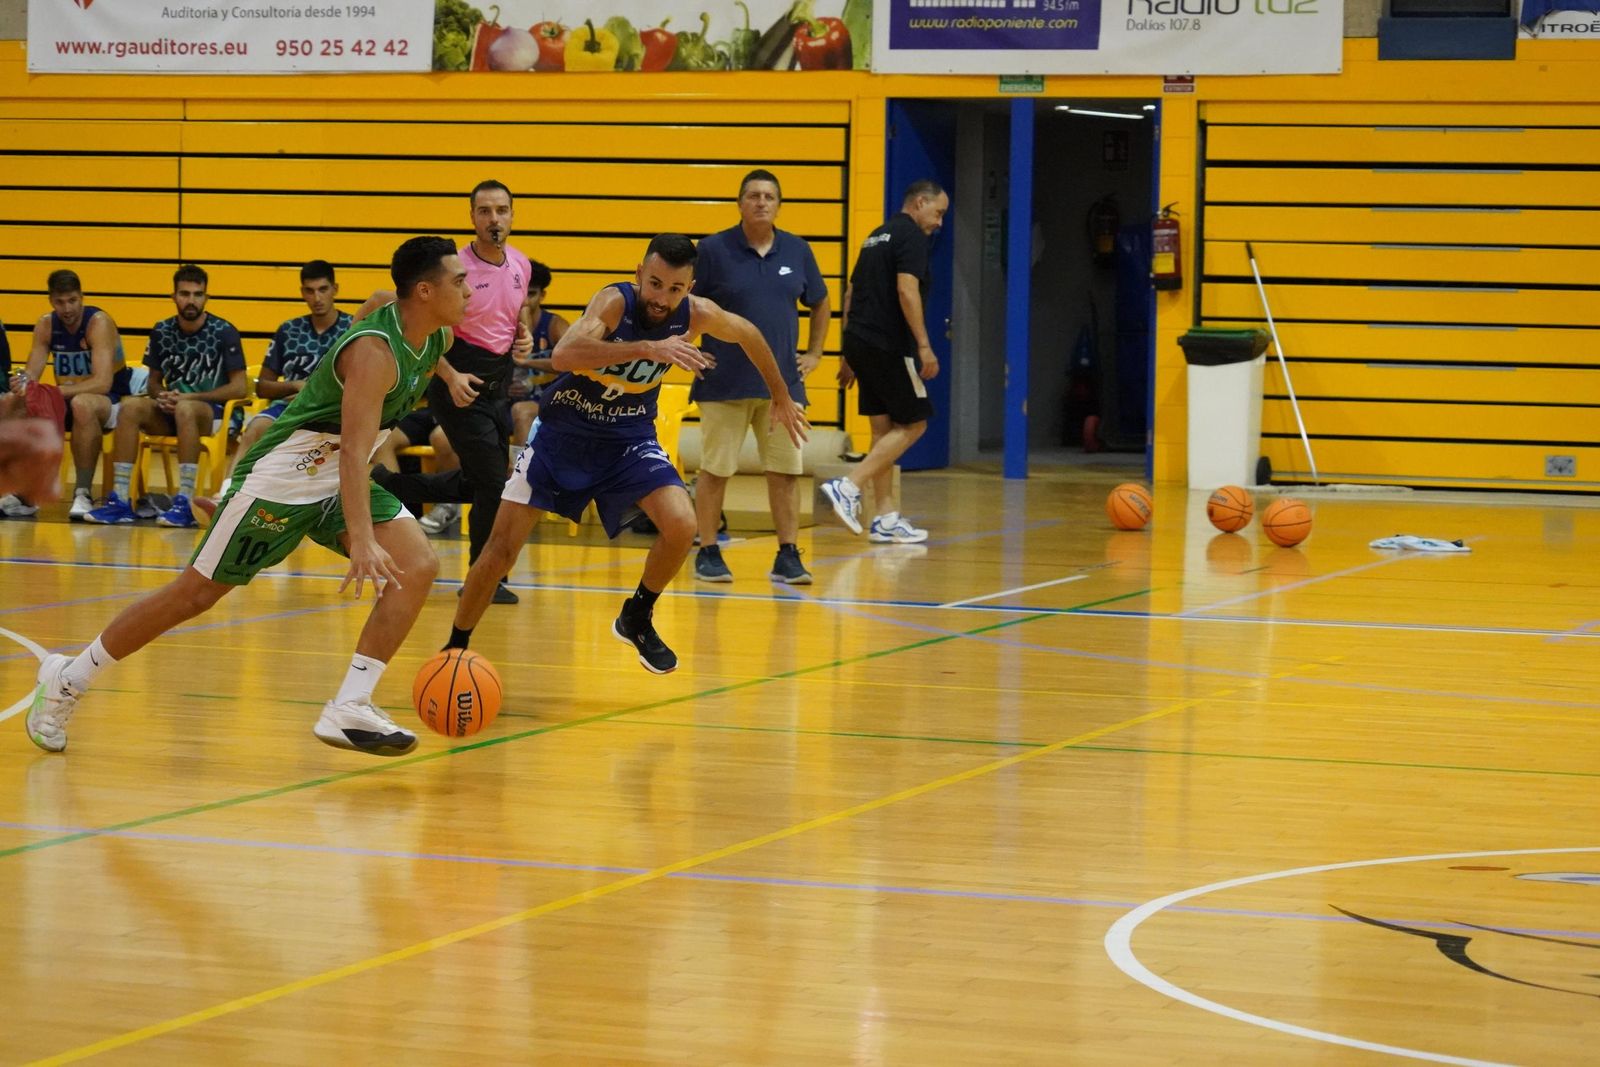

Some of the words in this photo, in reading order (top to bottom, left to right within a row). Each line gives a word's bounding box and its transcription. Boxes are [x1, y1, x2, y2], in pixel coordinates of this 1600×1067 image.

[221, 8, 228, 21] y
[304, 5, 342, 18] desde
[346, 5, 376, 18] 1994
[1169, 18, 1201, 31] 107.8
[56, 38, 248, 57] www.rgauditores.eu
[275, 39, 313, 56] 950
[320, 39, 344, 56] 25
[351, 39, 376, 56] 42
[383, 39, 408, 56] 42
[235, 535, 269, 566] 10
